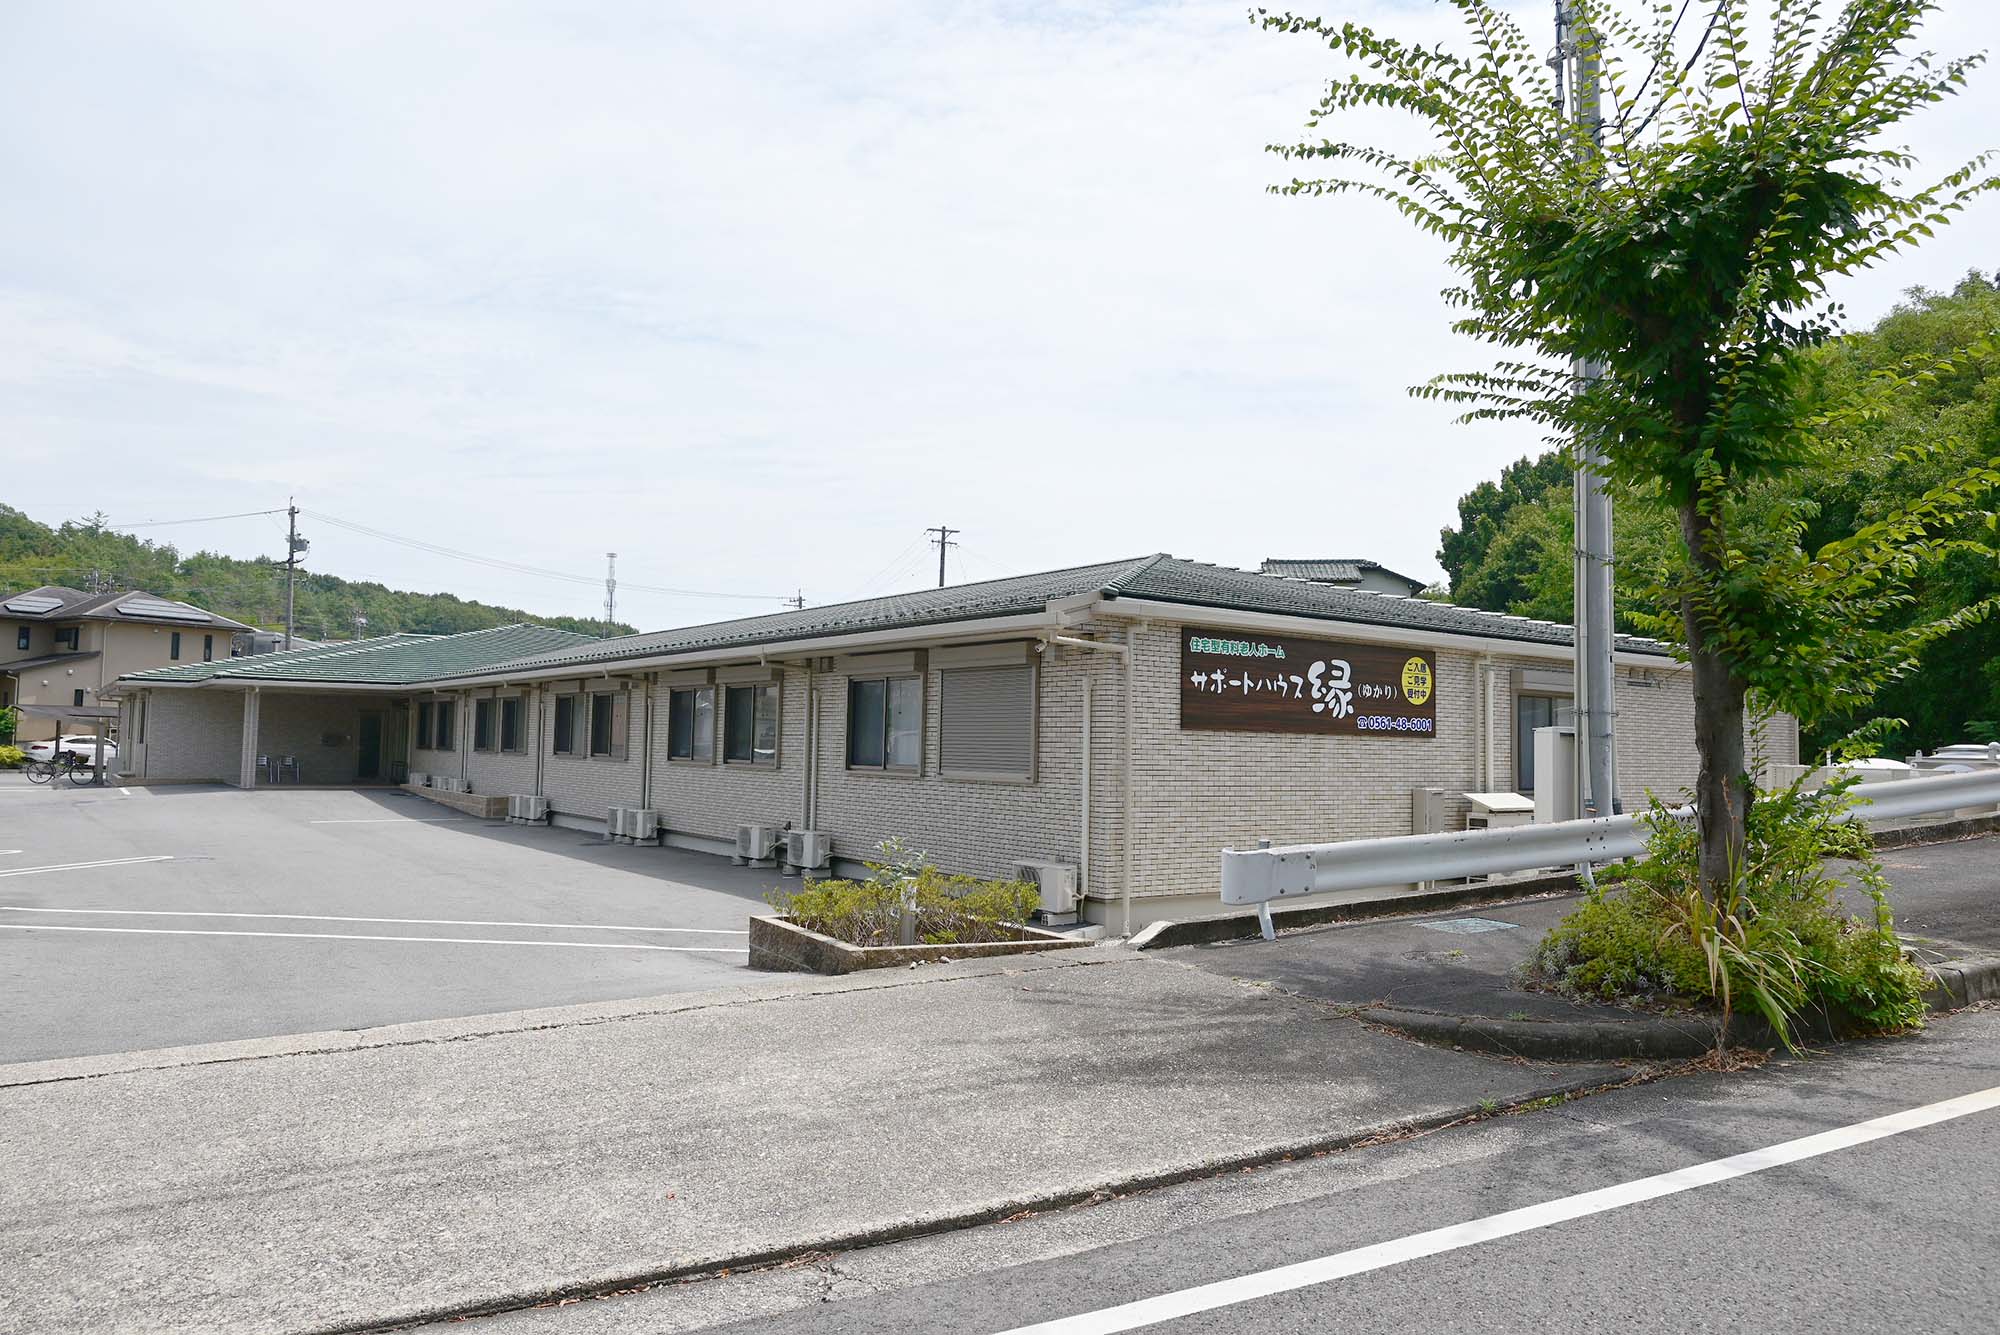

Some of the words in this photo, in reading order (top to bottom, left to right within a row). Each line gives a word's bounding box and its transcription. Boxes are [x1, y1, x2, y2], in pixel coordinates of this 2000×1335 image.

[1190, 637, 1286, 659] 住宅型有料老人ホーム
[1191, 668, 1304, 698] サポートハウス
[1307, 659, 1354, 719] 縁
[1407, 676, 1427, 687] ご見学
[1407, 689, 1427, 700] 受付中
